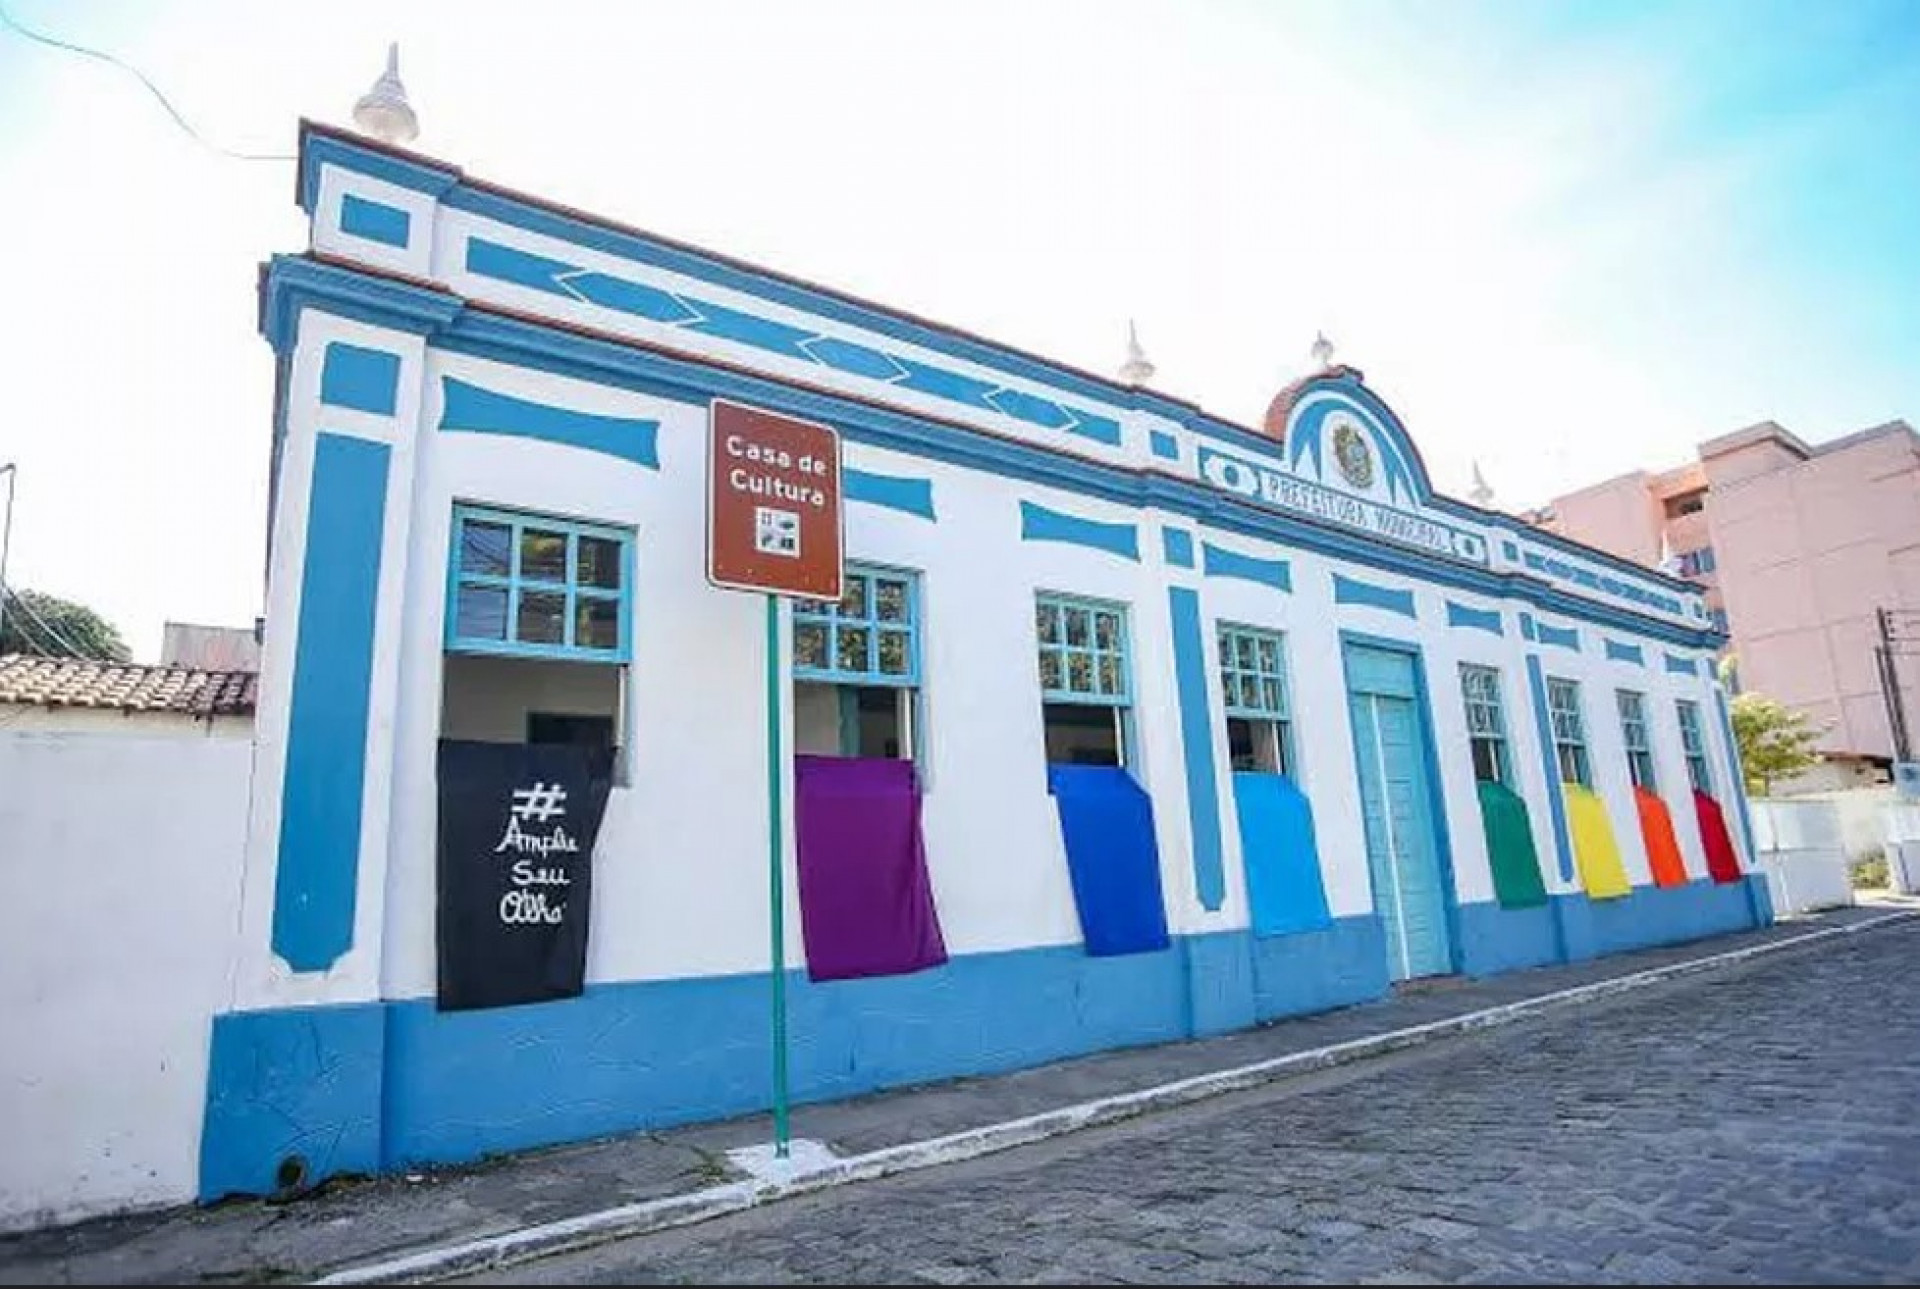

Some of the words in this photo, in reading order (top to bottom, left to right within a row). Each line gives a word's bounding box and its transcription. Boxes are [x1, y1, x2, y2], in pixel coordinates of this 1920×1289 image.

[727, 434, 791, 467] Casa
[798, 454, 827, 474] de
[730, 468, 825, 506] Cultura
[512, 860, 571, 885] Seu
